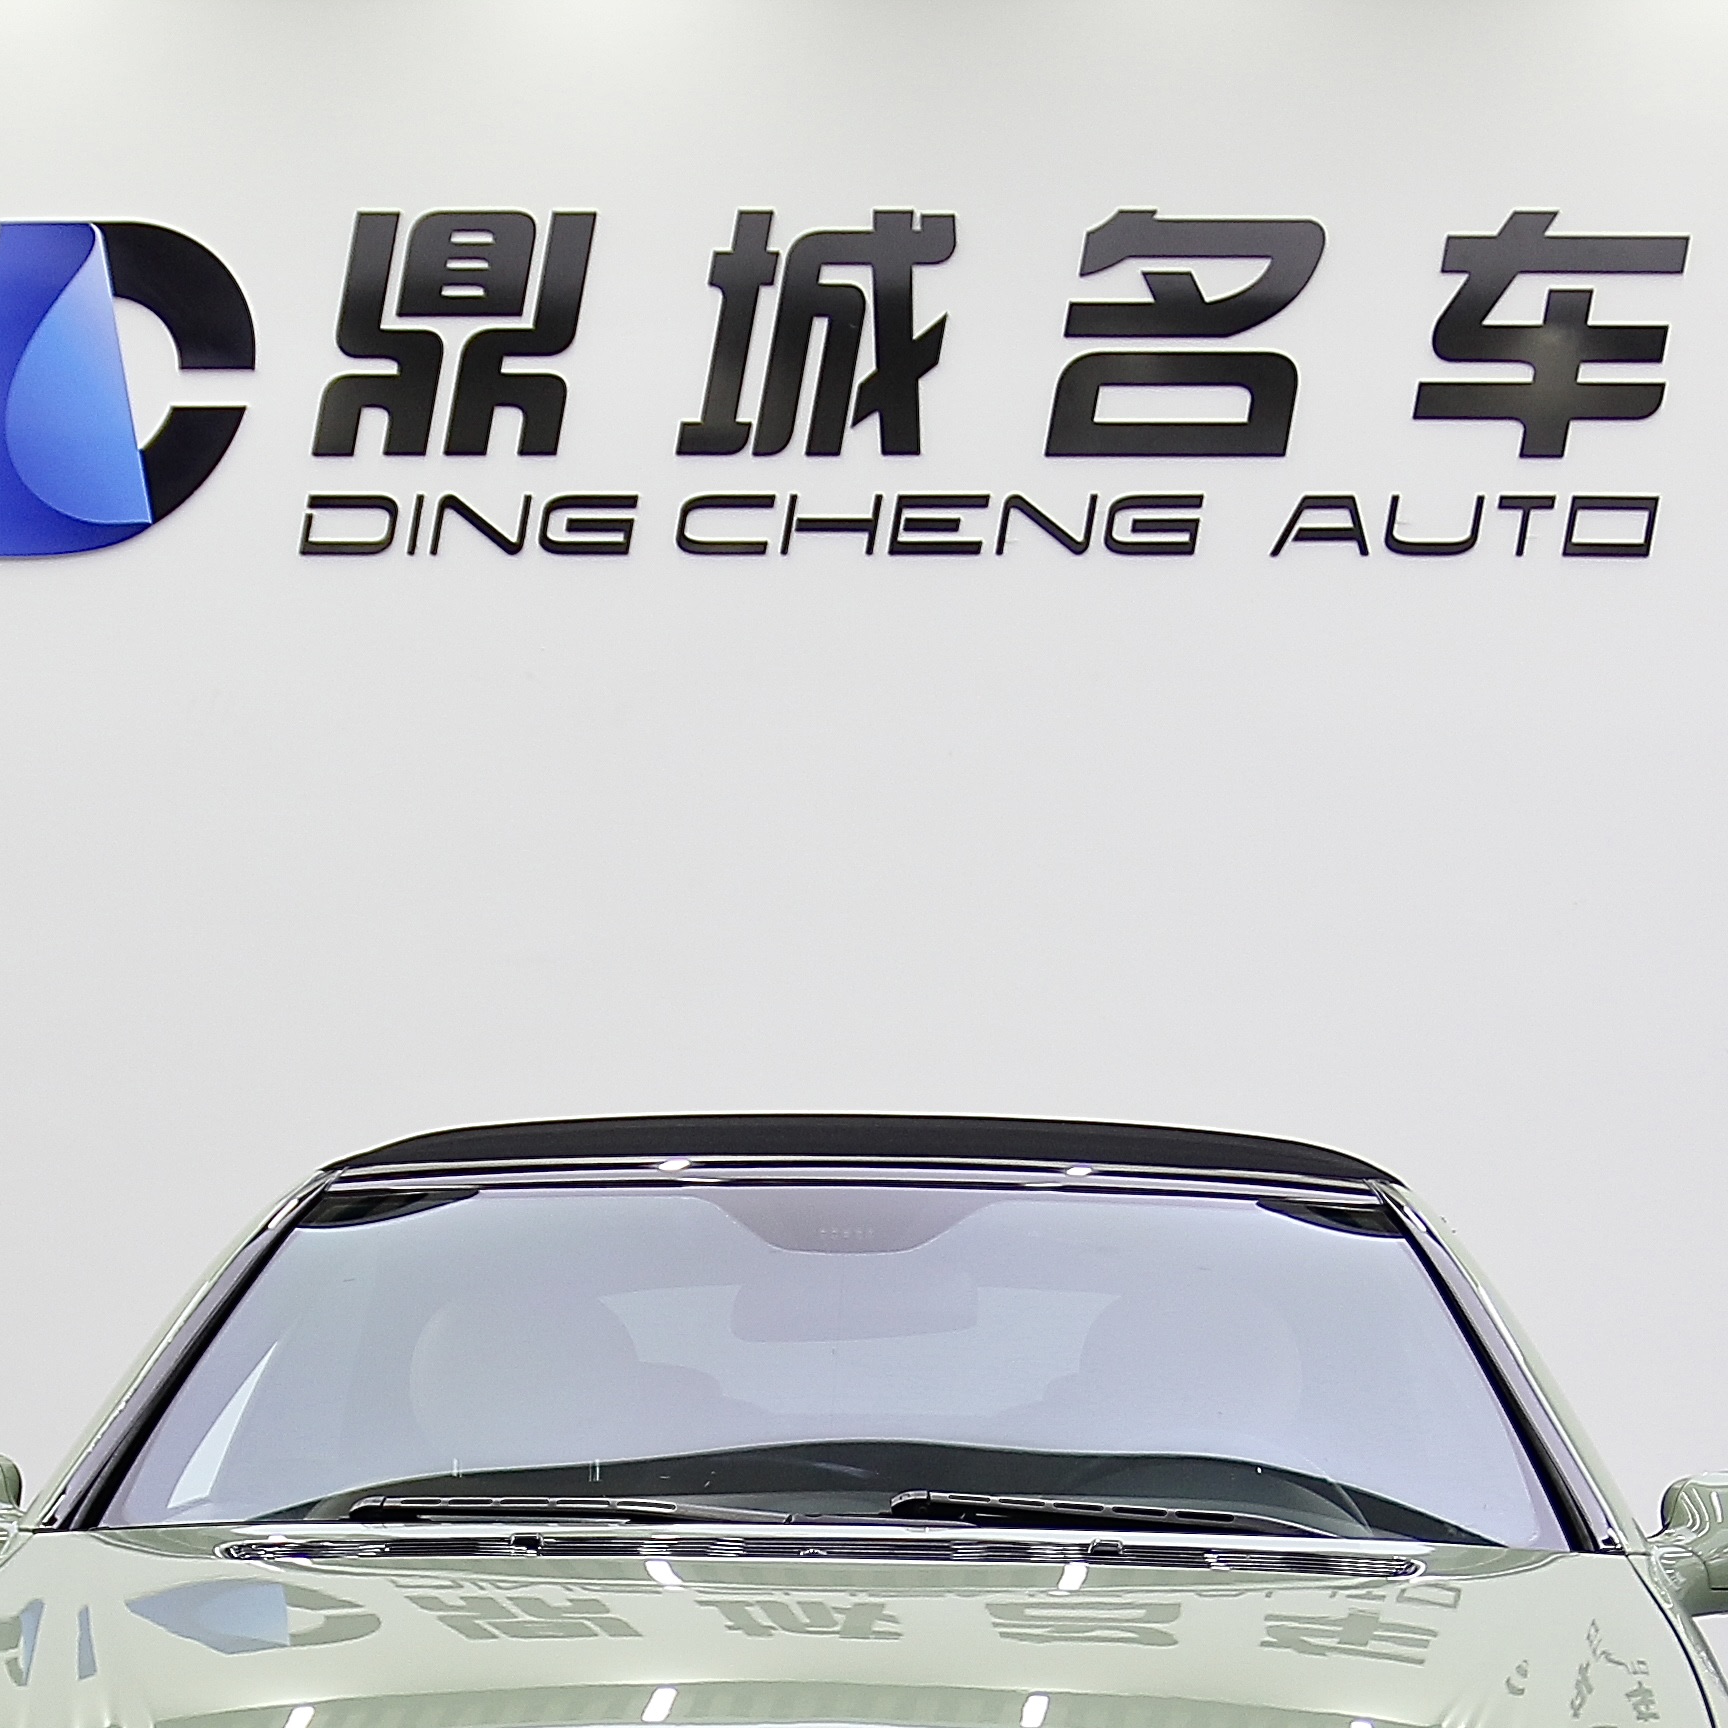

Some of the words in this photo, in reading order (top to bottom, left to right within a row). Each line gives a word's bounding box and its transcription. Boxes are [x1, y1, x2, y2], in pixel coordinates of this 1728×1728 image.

[311, 209, 1690, 459] 鼎城名车
[299, 493, 639, 557] DING
[675, 493, 1205, 557] CHENG
[1269, 494, 1660, 559] AUTO
